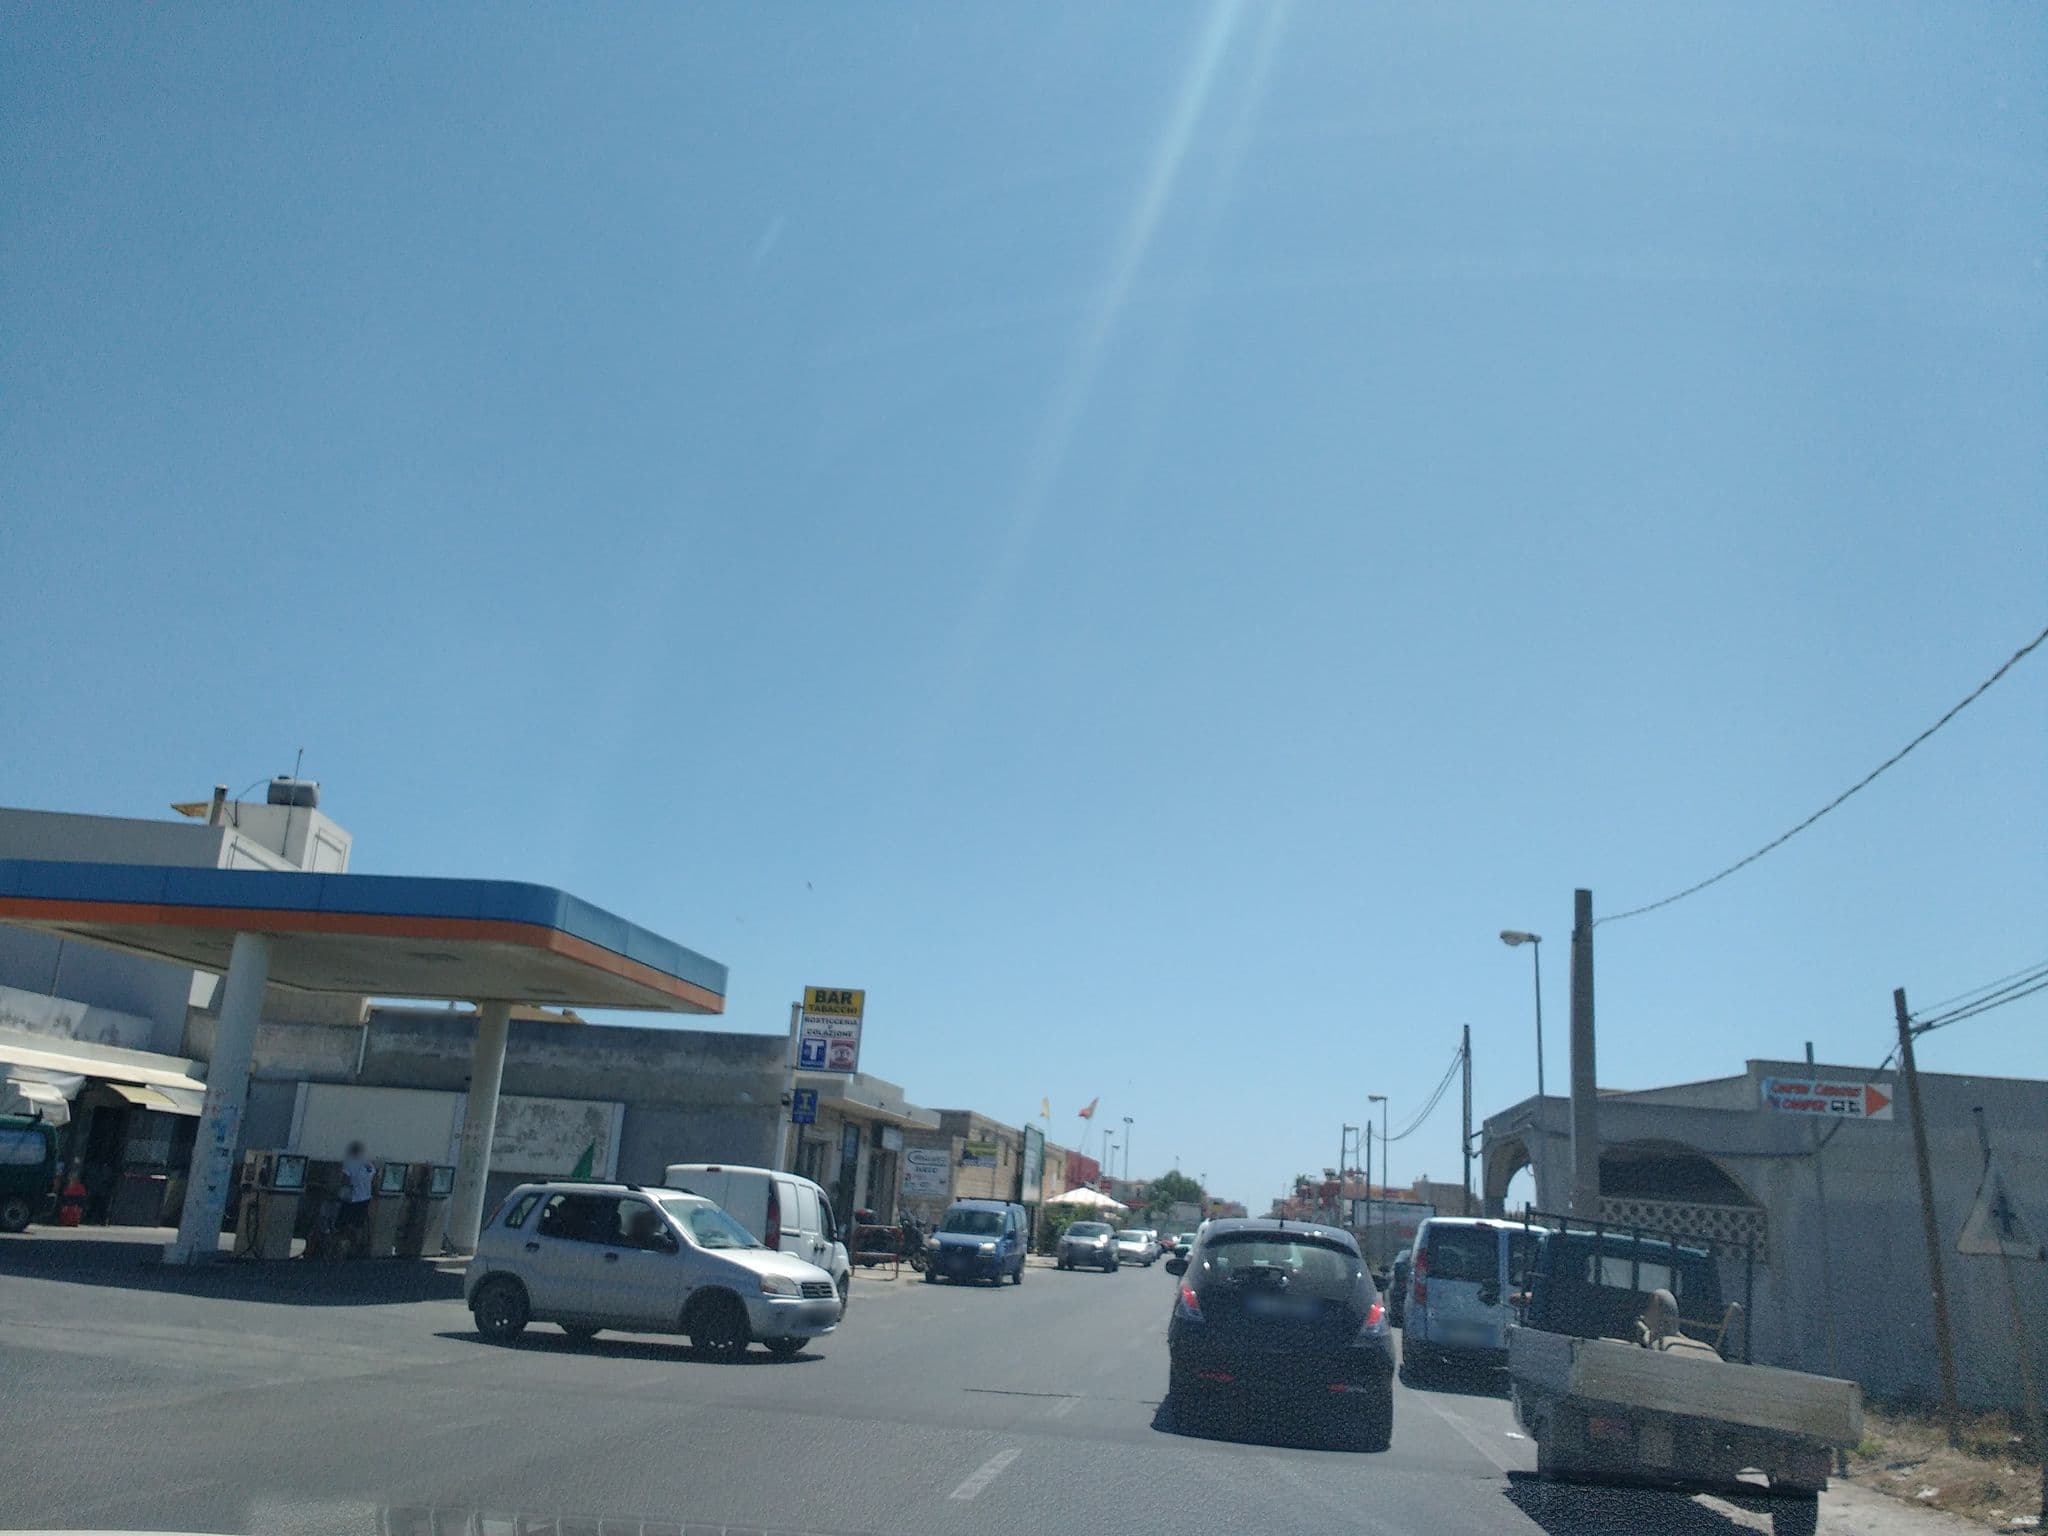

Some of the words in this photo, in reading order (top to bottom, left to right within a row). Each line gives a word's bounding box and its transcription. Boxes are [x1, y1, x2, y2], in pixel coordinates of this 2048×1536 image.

[815, 989, 853, 1005] BAR
[808, 1004, 858, 1014] TABACCHI
[805, 1040, 825, 1061] T
